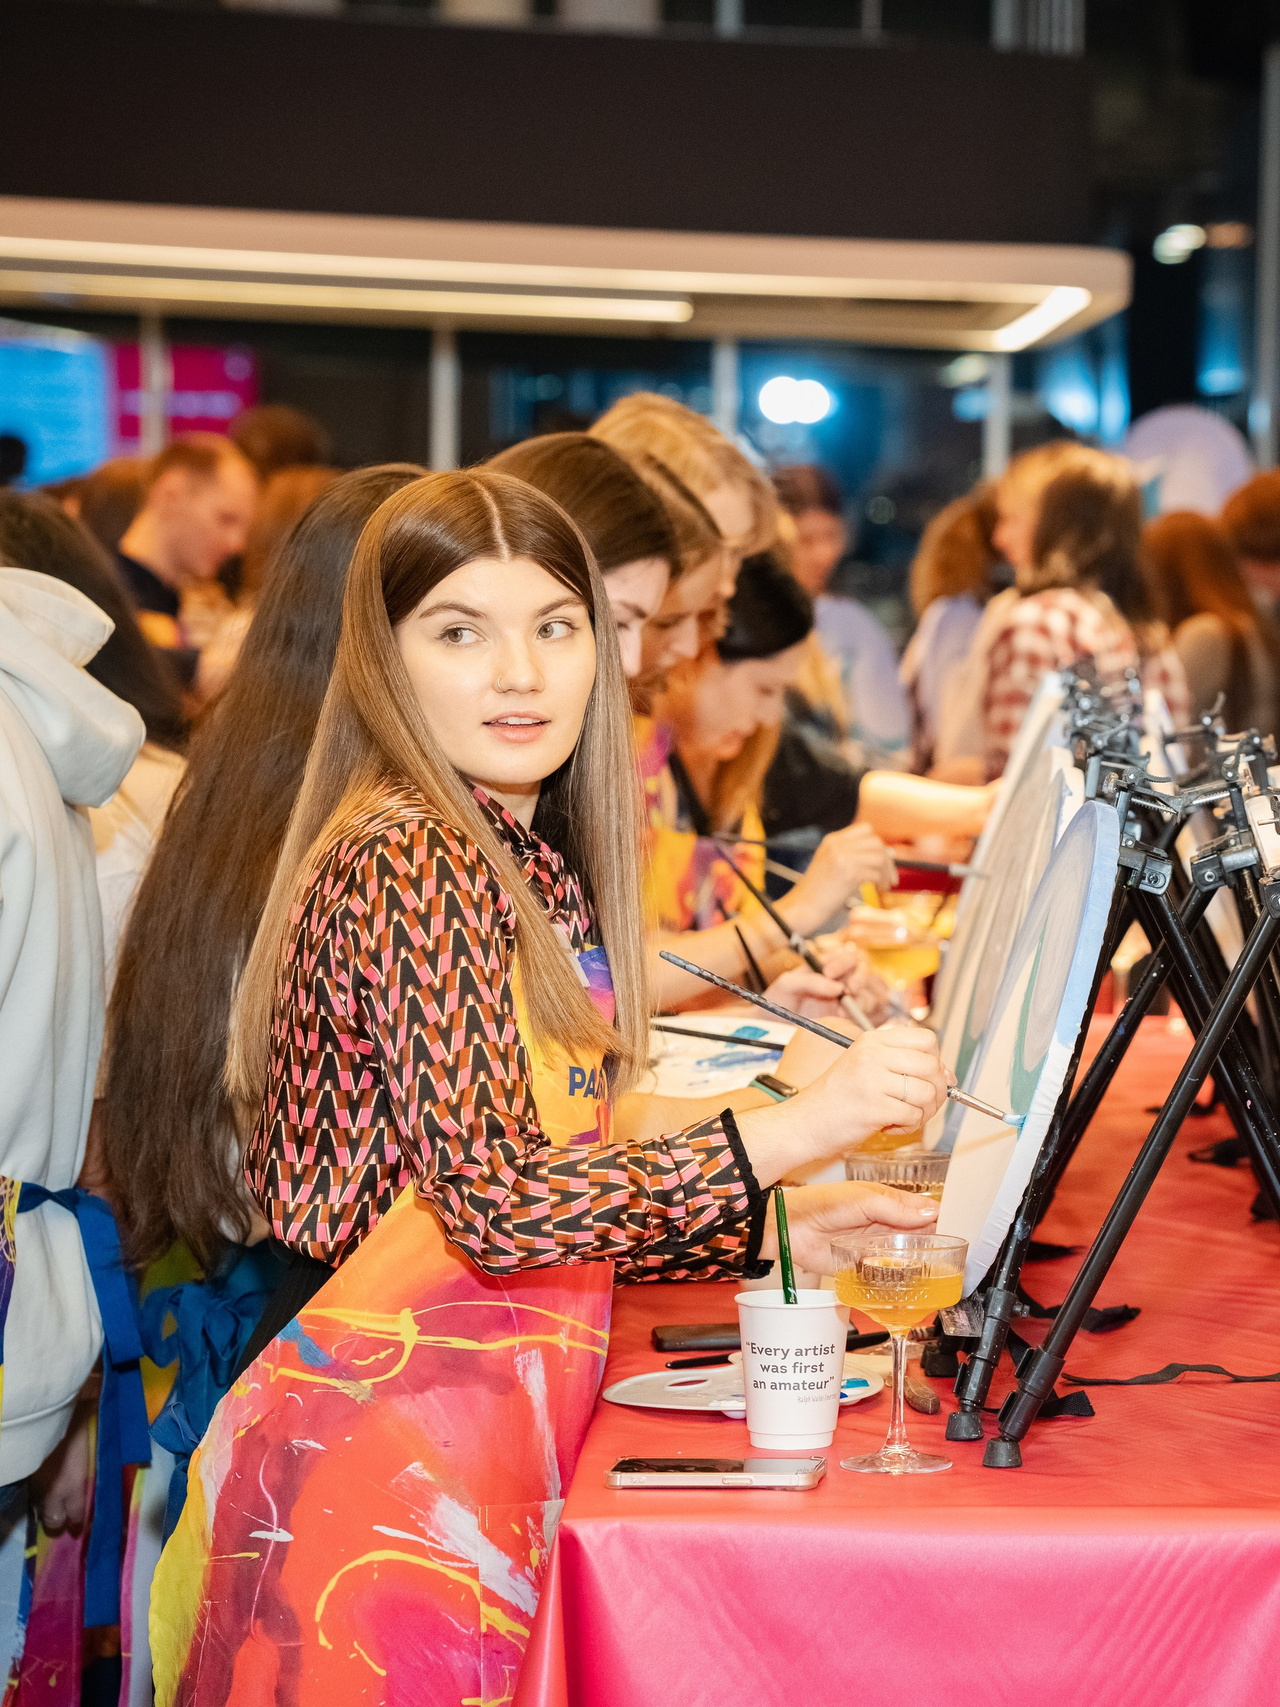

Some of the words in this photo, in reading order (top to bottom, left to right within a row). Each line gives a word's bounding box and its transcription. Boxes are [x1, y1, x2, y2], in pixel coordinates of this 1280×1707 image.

[794, 1343, 835, 1357] artist
[760, 1363, 788, 1374] was
[792, 1361, 824, 1374] first
[753, 1379, 766, 1389] an
